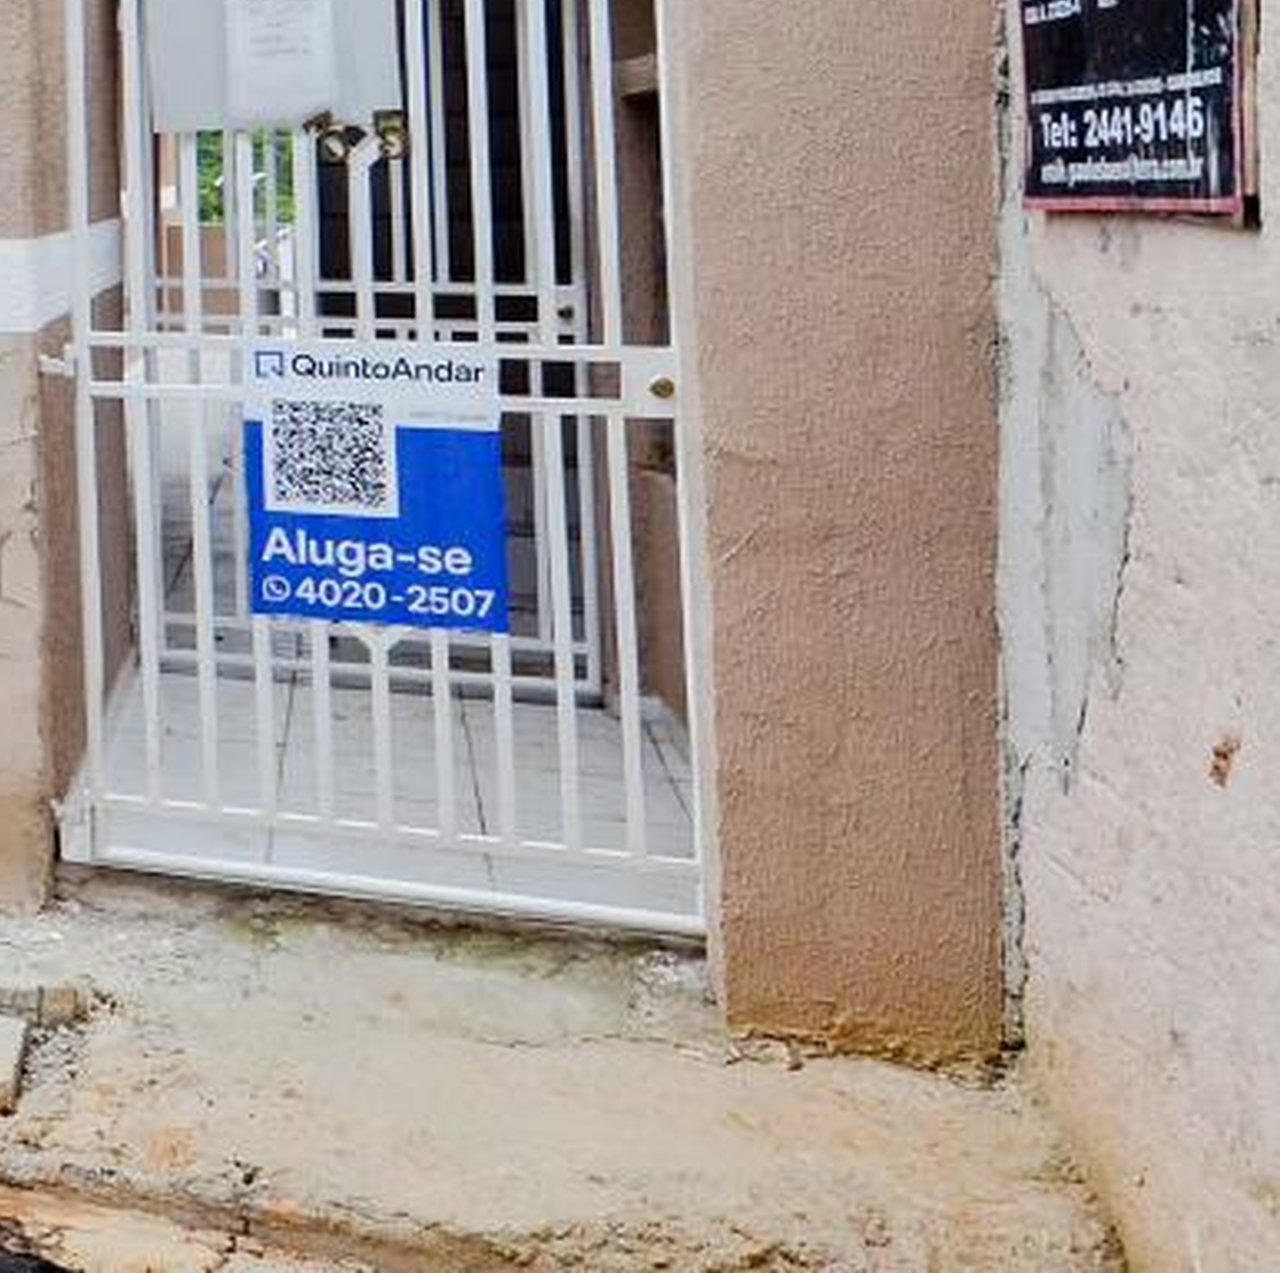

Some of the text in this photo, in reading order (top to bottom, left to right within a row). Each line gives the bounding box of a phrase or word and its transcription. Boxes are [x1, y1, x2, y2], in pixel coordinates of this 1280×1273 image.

[1040, 95, 1205, 149] Tel: 2441-9146
[291, 353, 486, 384] QuintoAndar
[262, 526, 473, 577] Aluga-se
[295, 576, 496, 619] 4020-2507
